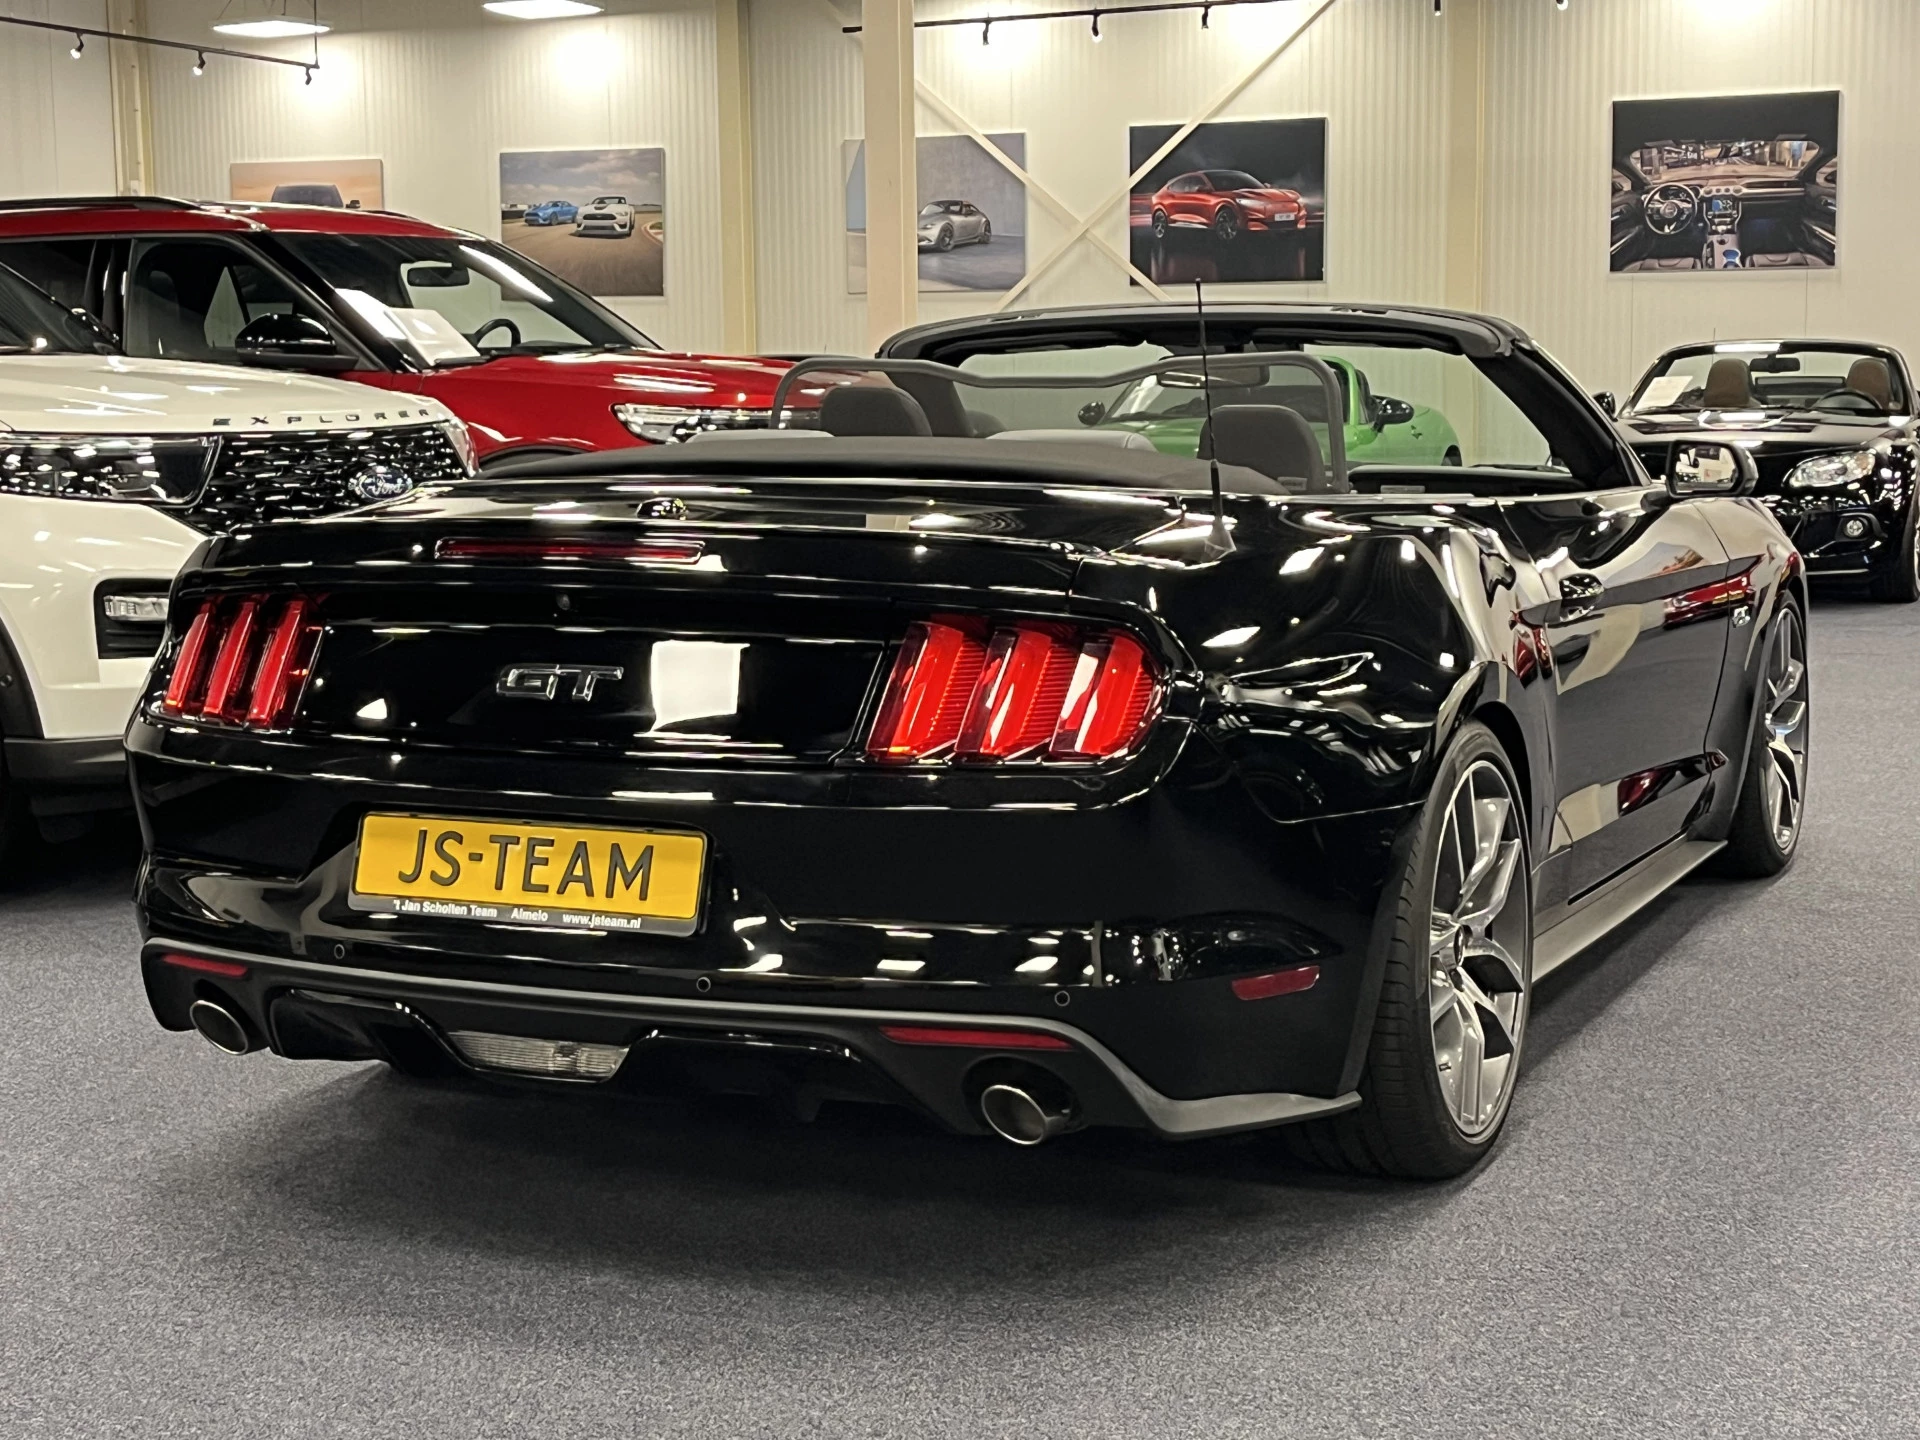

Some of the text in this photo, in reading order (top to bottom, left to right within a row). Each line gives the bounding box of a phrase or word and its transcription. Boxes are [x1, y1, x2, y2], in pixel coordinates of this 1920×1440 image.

[212, 408, 429, 427] EXPLORER
[496, 663, 623, 701] GT
[398, 829, 654, 901] JS-TEAM
[401, 899, 421, 912] Jan
[422, 901, 468, 915] Scholten
[469, 905, 498, 918] Team
[562, 913, 642, 929] www.jsteam.nl
